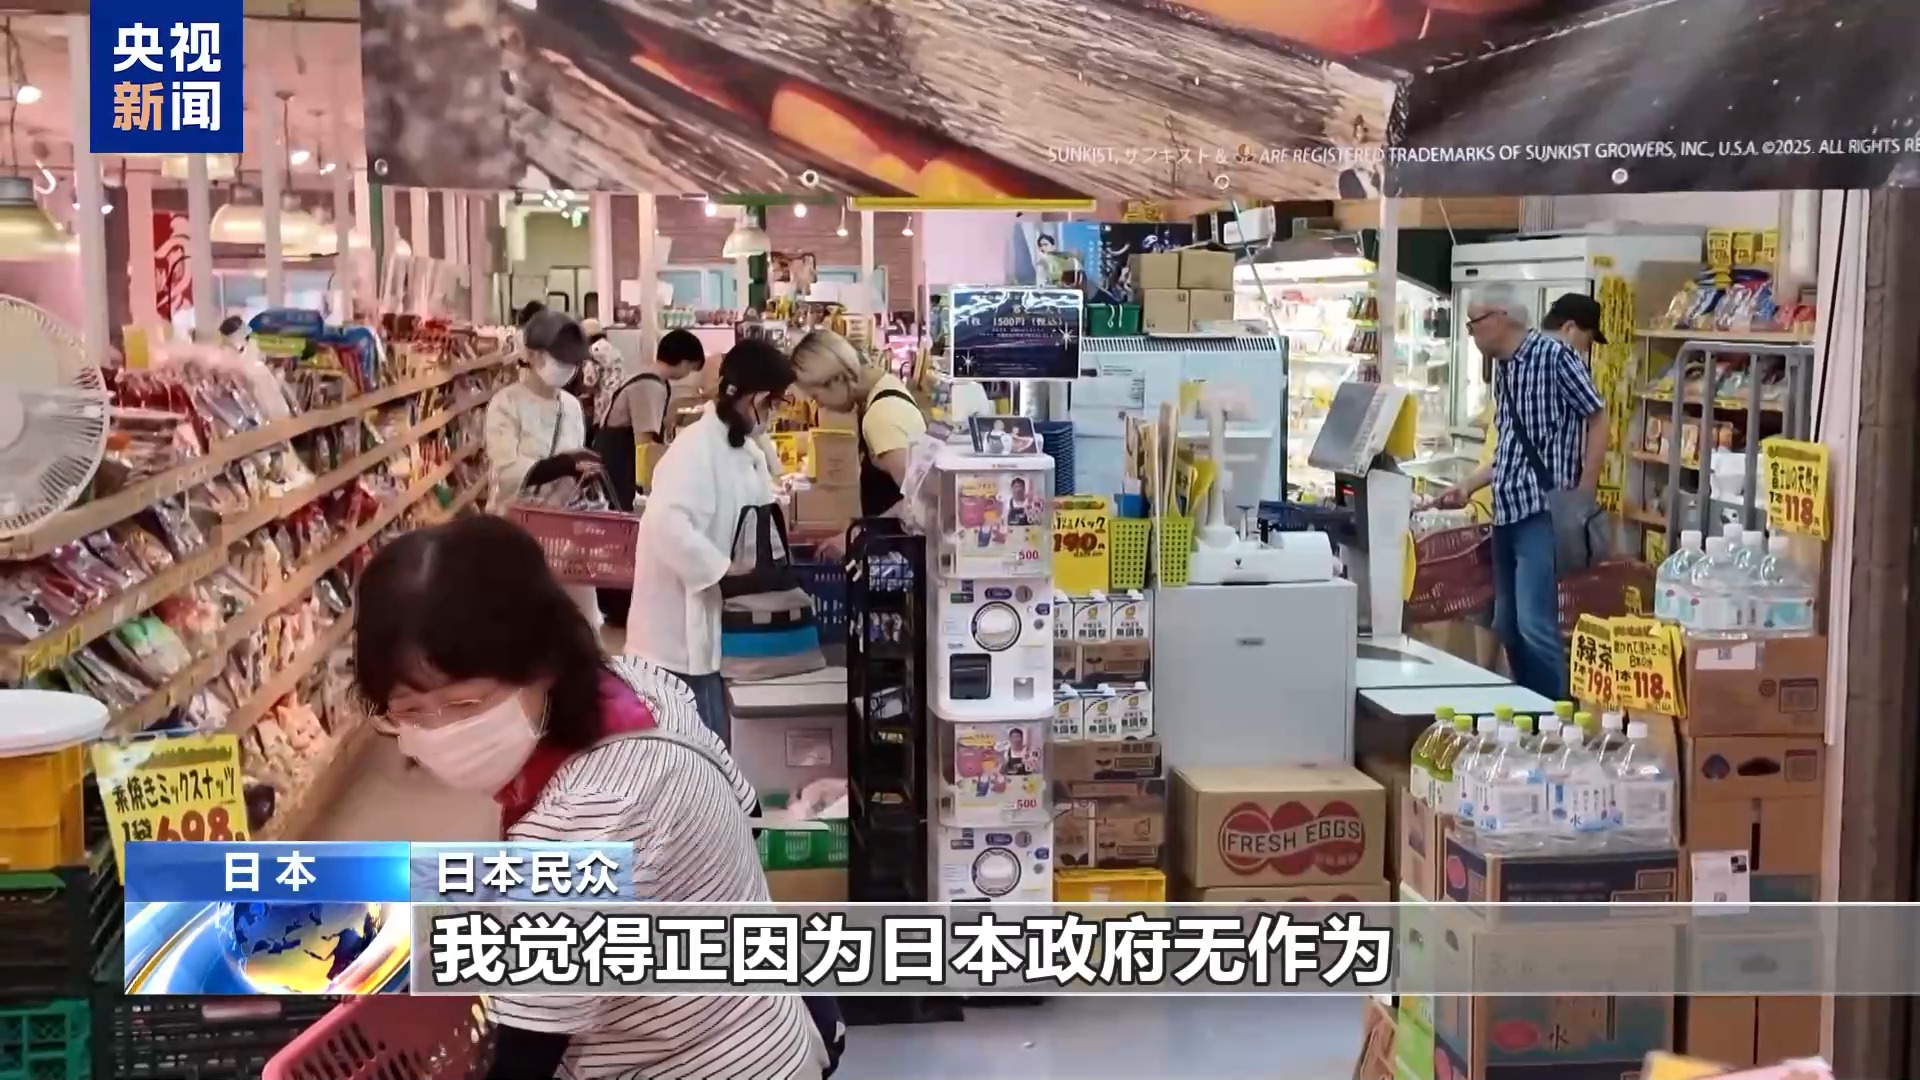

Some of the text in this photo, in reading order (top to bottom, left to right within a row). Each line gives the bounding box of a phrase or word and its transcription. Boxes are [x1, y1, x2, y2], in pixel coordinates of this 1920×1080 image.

[1049, 147, 1119, 164] SUNKIST,
[1215, 148, 1227, 164] &
[1259, 149, 1289, 164] ARE
[1293, 148, 1385, 164] REGISTERED
[1388, 145, 1496, 163] TRADEMARKS
[1499, 144, 1522, 161] OF
[1526, 143, 1591, 162] SUNKIST
[1595, 141, 1677, 160] GROWERS,
[1818, 138, 1846, 155] ALL
[1848, 137, 1901, 155] RIGHTS
[1018, 549, 1039, 560] 500
[1226, 819, 1361, 853] FRESH EGGS
